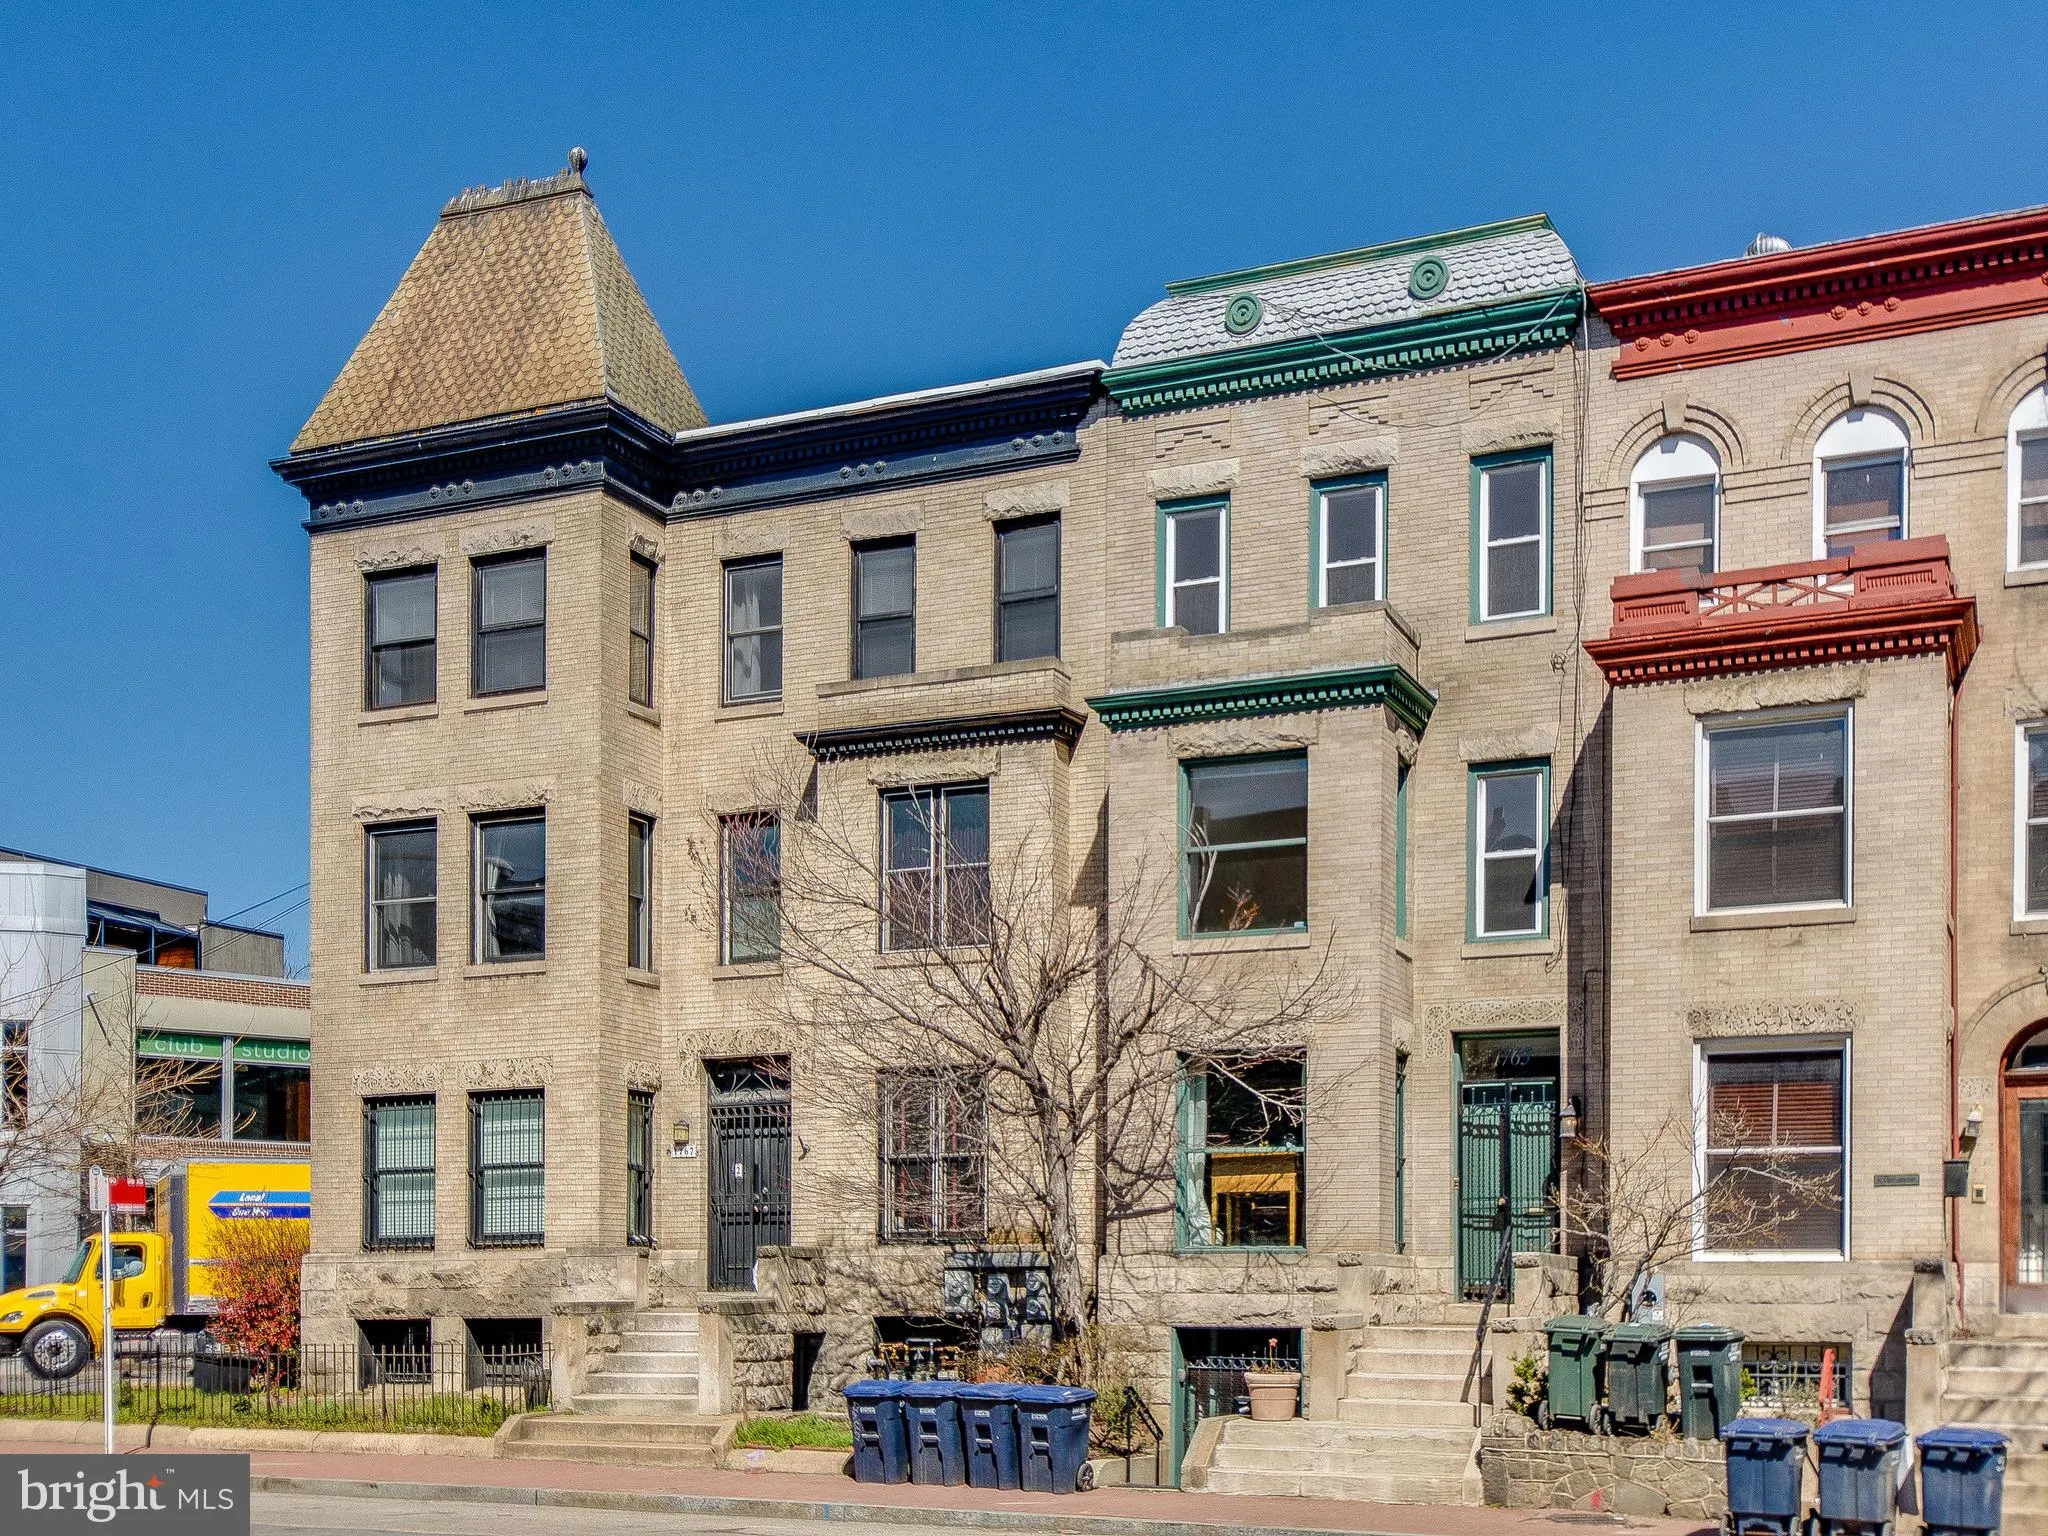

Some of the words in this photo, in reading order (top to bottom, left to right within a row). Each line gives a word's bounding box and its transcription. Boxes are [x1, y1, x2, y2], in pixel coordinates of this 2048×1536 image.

[154, 1037, 203, 1053] club
[241, 1044, 311, 1061] studio
[239, 1192, 266, 1202] Local
